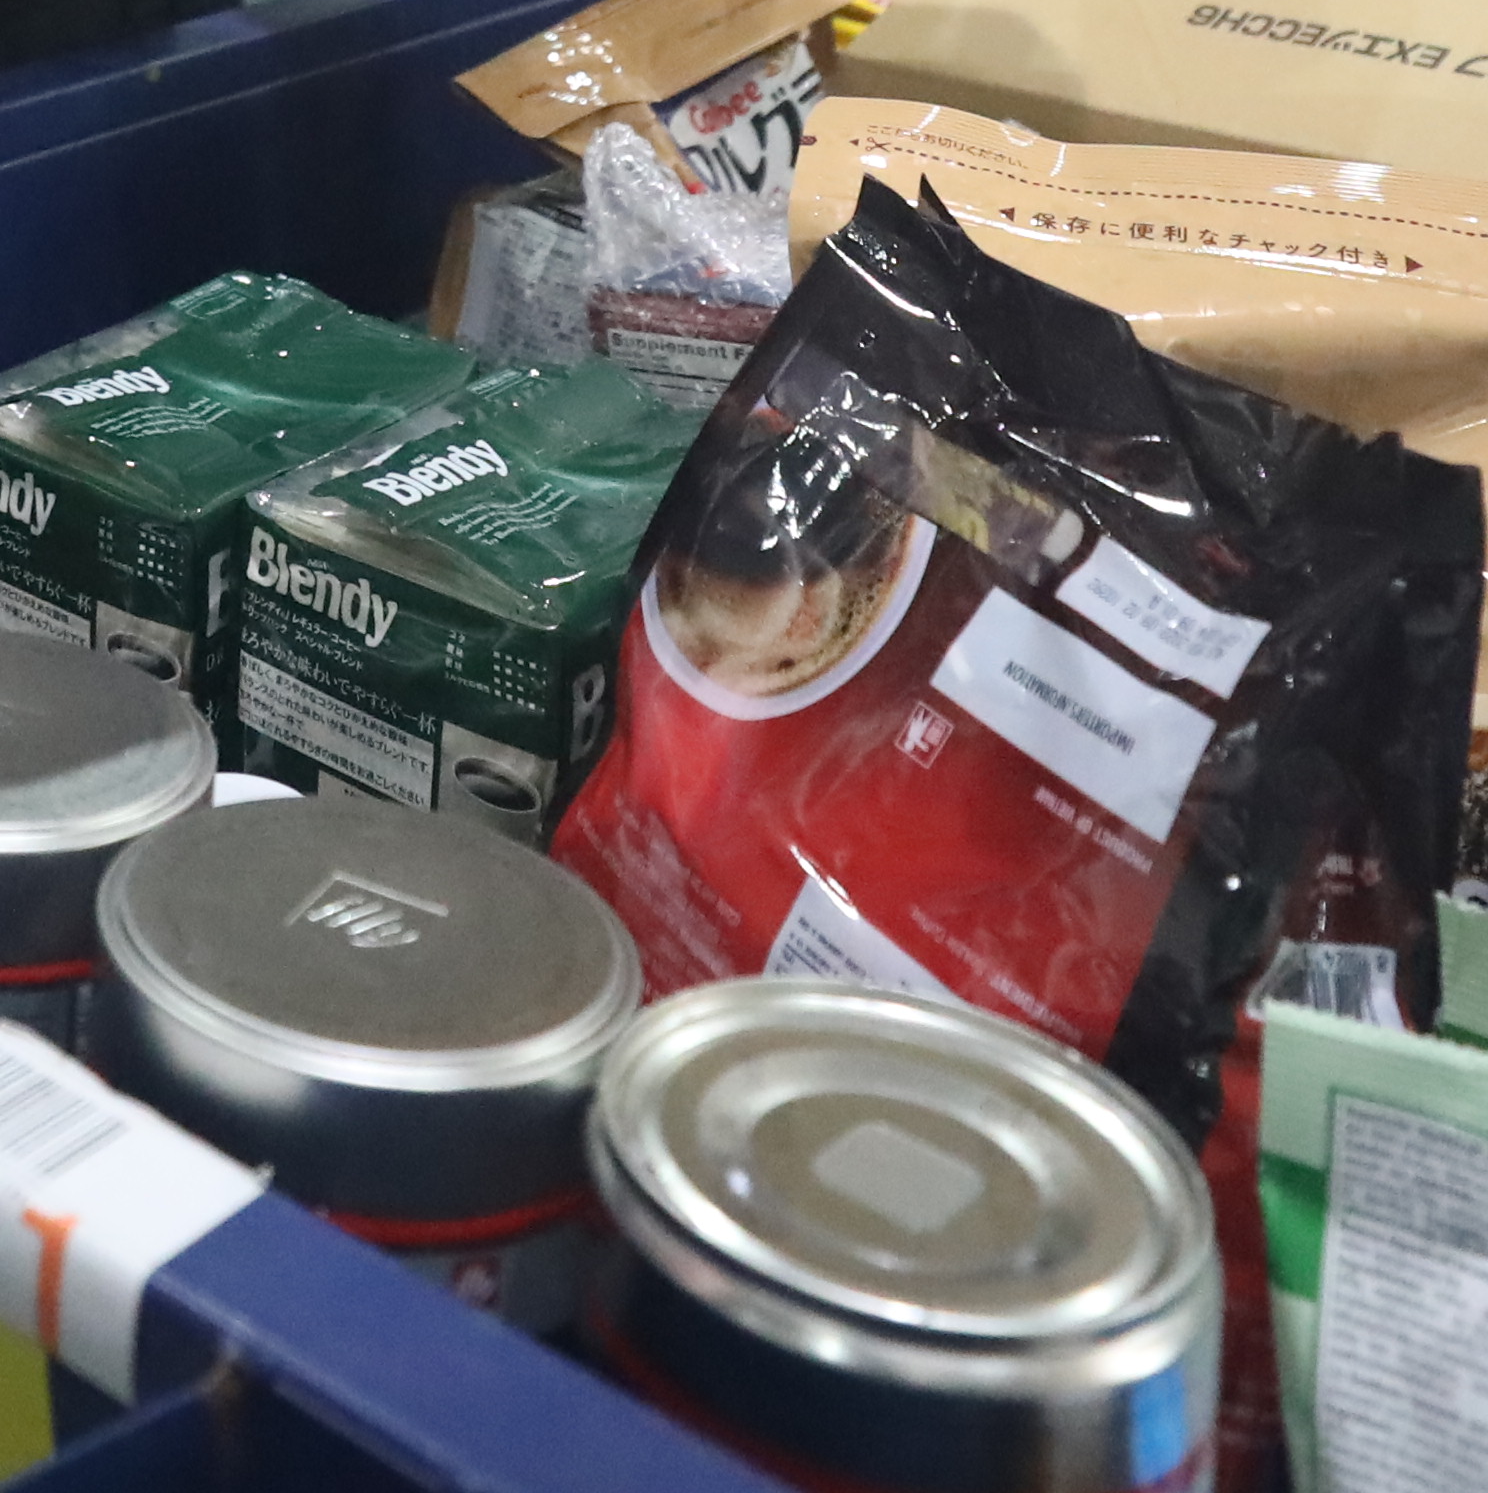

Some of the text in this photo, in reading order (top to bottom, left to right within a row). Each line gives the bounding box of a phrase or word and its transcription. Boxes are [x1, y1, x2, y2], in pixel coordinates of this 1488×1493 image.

[1033, 211, 1390, 268] 保存に便利なチャック付き
[611, 333, 727, 359] Supplement
[38, 366, 170, 406] Blendy
[363, 439, 509, 506] Blendy
[247, 526, 398, 648] Blendy
